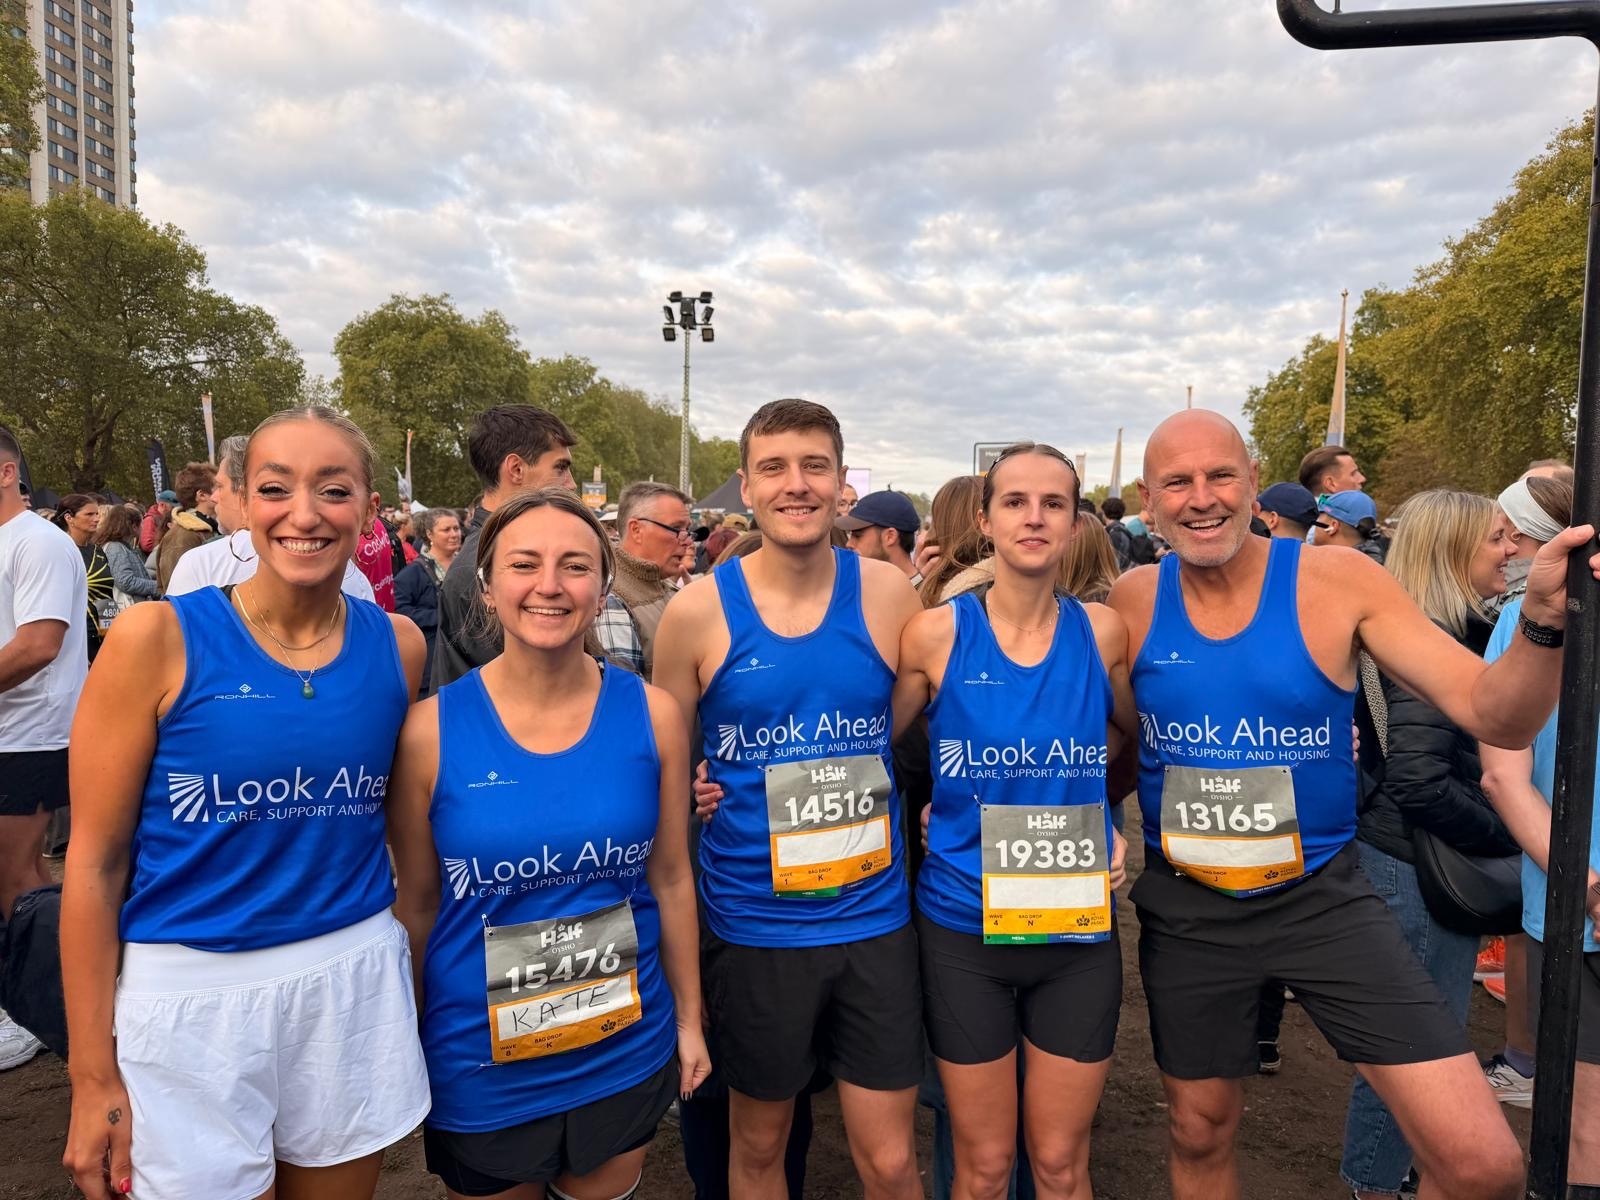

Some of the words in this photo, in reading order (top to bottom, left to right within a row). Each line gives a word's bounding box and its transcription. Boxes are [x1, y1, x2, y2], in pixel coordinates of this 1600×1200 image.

[740, 714, 806, 748] Look
[814, 706, 888, 741] Ahead
[1151, 714, 1223, 745] Look
[1231, 716, 1330, 747] Ahead
[745, 750, 772, 761] CARE,
[775, 744, 824, 757] SUPPORT
[827, 742, 848, 754] AND
[850, 735, 888, 751] HOUSING
[967, 737, 1038, 766] Look
[1045, 737, 1107, 765] Ahea
[1160, 742, 1186, 757] CARE,
[1188, 746, 1242, 760] SUPPORT
[1245, 750, 1274, 761] AND
[1279, 749, 1330, 761] HOUSING
[212, 766, 316, 806] Look
[324, 764, 389, 798] Ahea
[467, 779, 519, 788] RONHILL
[811, 764, 847, 784] Half
[969, 769, 1001, 780] CARE,
[1003, 768, 1054, 779] SUPPORT
[1057, 768, 1080, 779] AND
[1200, 776, 1242, 793] Half
[216, 809, 262, 824] CARE,
[266, 805, 336, 820] SUPPORT
[337, 803, 364, 816] AND
[785, 787, 874, 827] 14516
[1027, 811, 1067, 829] Half
[1175, 801, 1277, 832] 13165
[472, 845, 563, 884] Look
[995, 838, 1096, 869] 19383
[479, 885, 516, 898] CARE,
[520, 873, 583, 892] SUPPORT
[586, 869, 615, 881] AND
[540, 922, 583, 948] Half
[551, 943, 576, 954] OYSHO
[505, 942, 621, 993] 15476
[512, 984, 609, 1032] KATE
[535, 1036, 547, 1044] BAG
[547, 1032, 563, 1041] DROP
